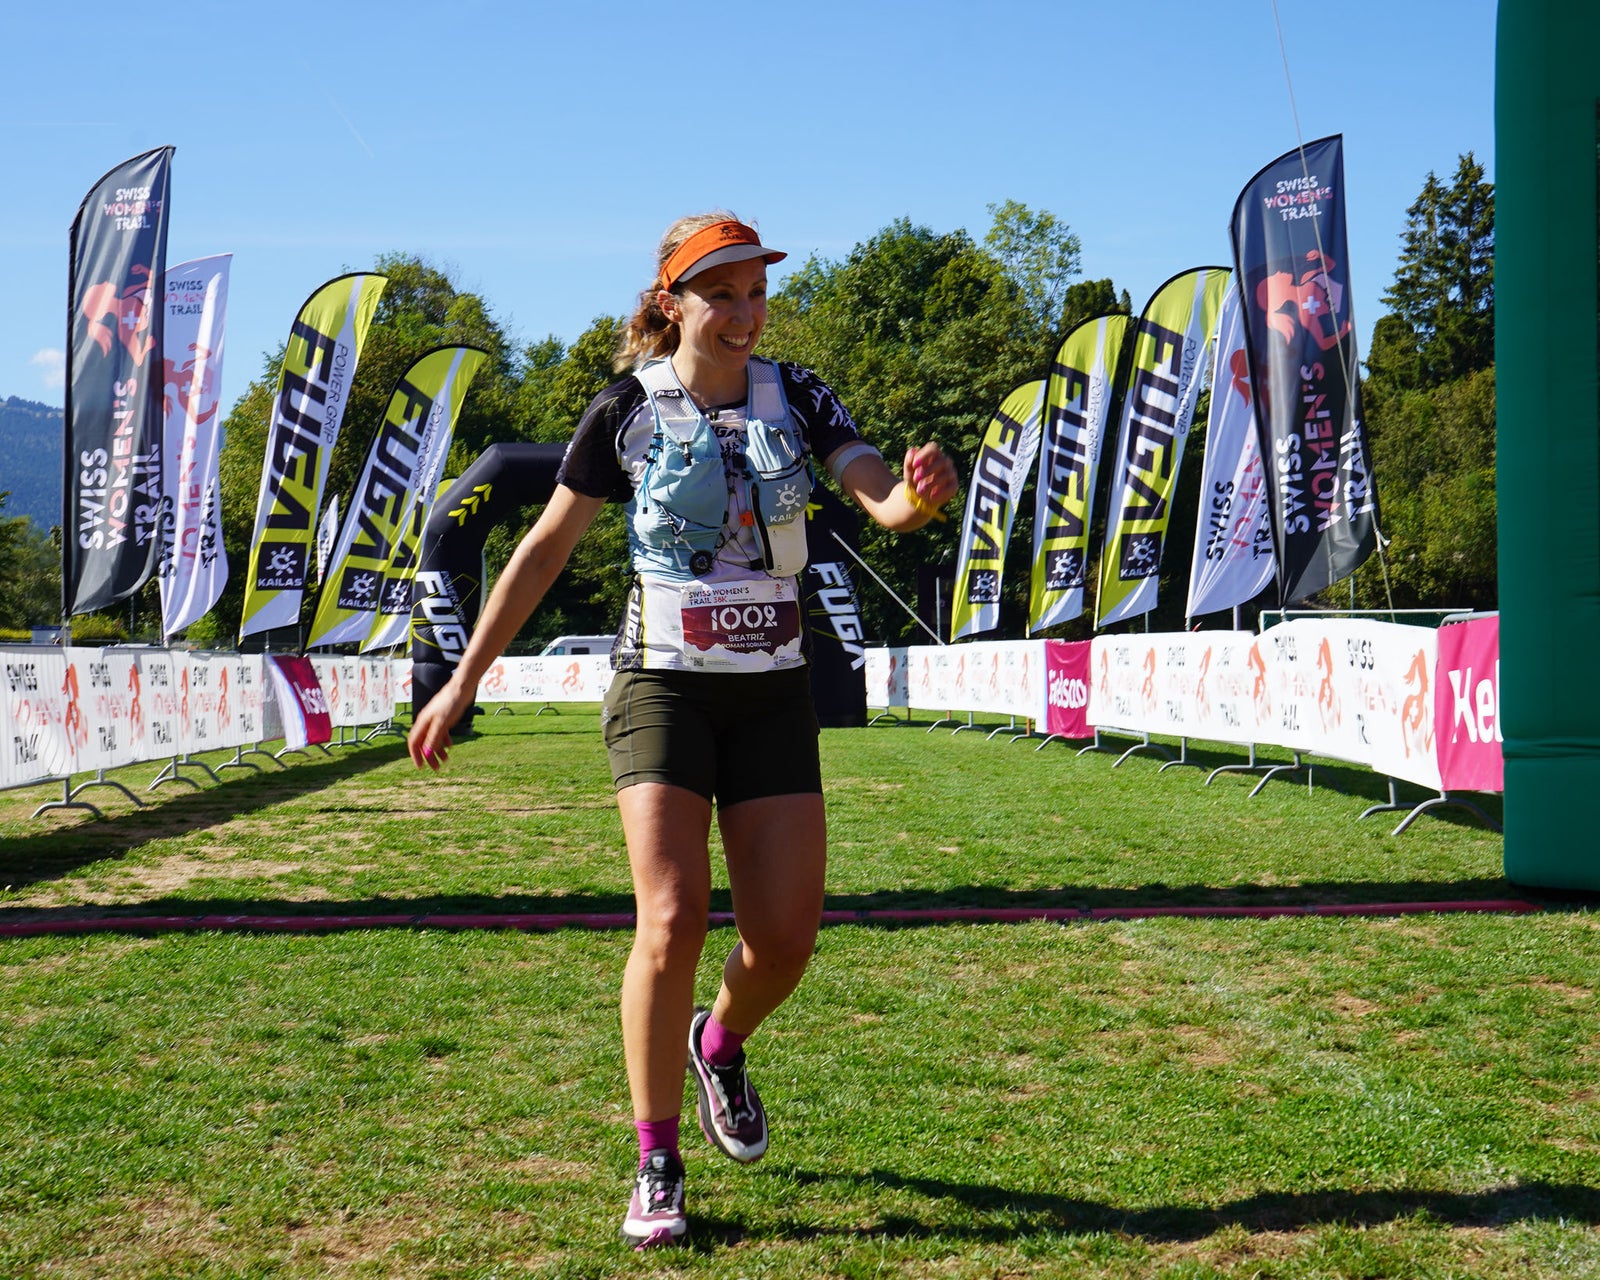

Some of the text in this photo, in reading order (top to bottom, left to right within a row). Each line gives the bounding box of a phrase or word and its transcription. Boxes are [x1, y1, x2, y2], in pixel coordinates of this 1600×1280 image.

[115, 186, 151, 202] SWISS
[1276, 175, 1318, 194] SWISS
[1264, 186, 1333, 209] WOMEN'S
[115, 215, 151, 231] TRAIL
[1279, 204, 1322, 222] TRAIL
[169, 280, 203, 292] SWISS
[169, 304, 203, 316] TRAIL
[323, 343, 350, 445] POWER GRIP
[267, 319, 336, 530] FUGA
[1122, 319, 1183, 521] FUGA
[1046, 361, 1090, 540] FUGA
[1300, 361, 1343, 533] WOMEN'S
[105, 377, 138, 551] WOMEN'S
[350, 378, 434, 561] FUGA
[1340, 419, 1376, 522] TRAIL
[970, 410, 1024, 560] FUGA
[1276, 433, 1310, 536] SWISS
[79, 448, 109, 550] SWISS
[1206, 480, 1235, 562] SWISS
[257, 576, 303, 588] KAILAS
[1046, 577, 1084, 590] KAILAS
[1120, 564, 1159, 578] KAILAS
[338, 598, 378, 609] KAILAS
[688, 586, 750, 599] SWISS WOMEN'S
[688, 597, 712, 606] TRAIL
[711, 604, 778, 631] 1002
[809, 562, 866, 671] FUGA
[727, 633, 766, 642] BEATRIZ
